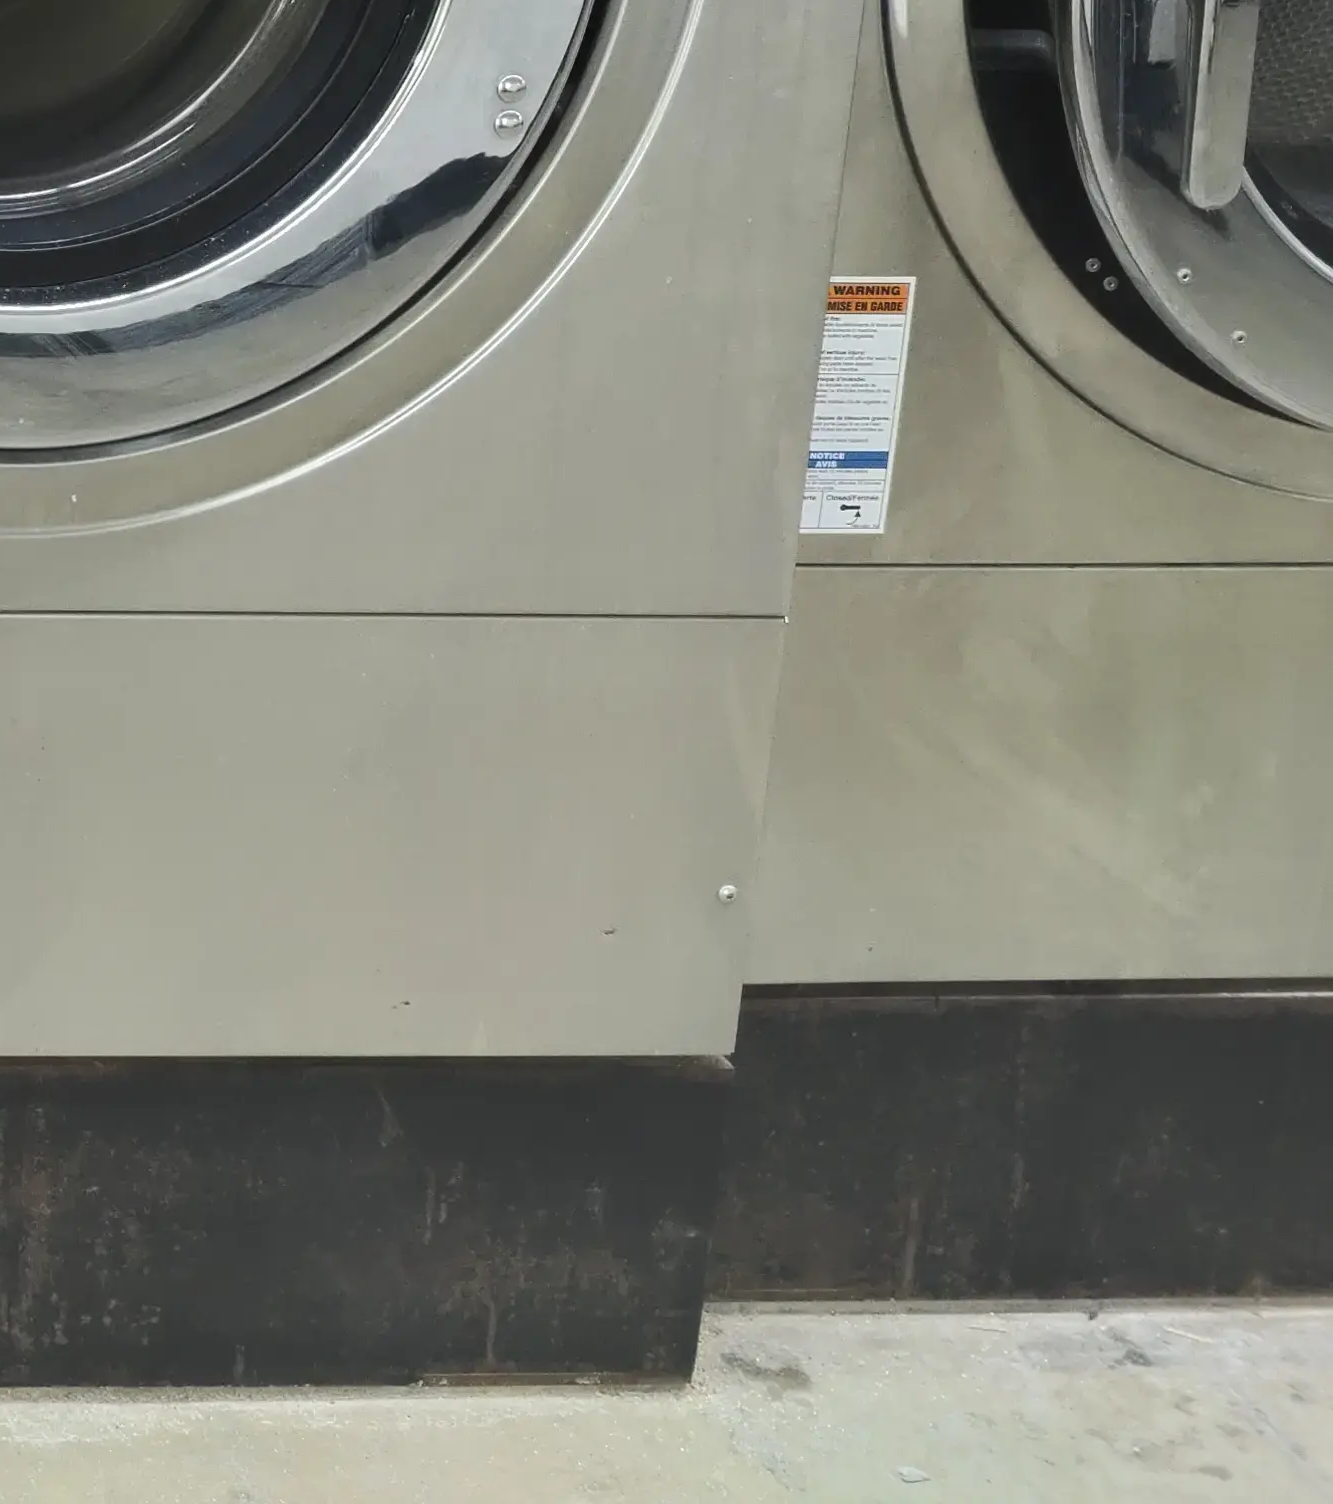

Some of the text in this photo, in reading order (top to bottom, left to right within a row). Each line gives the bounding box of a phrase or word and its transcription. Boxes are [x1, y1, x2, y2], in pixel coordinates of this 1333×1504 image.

[833, 286, 900, 295] WARNING
[827, 302, 903, 311] MISE EN GARDE
[810, 452, 845, 460] NOTICE
